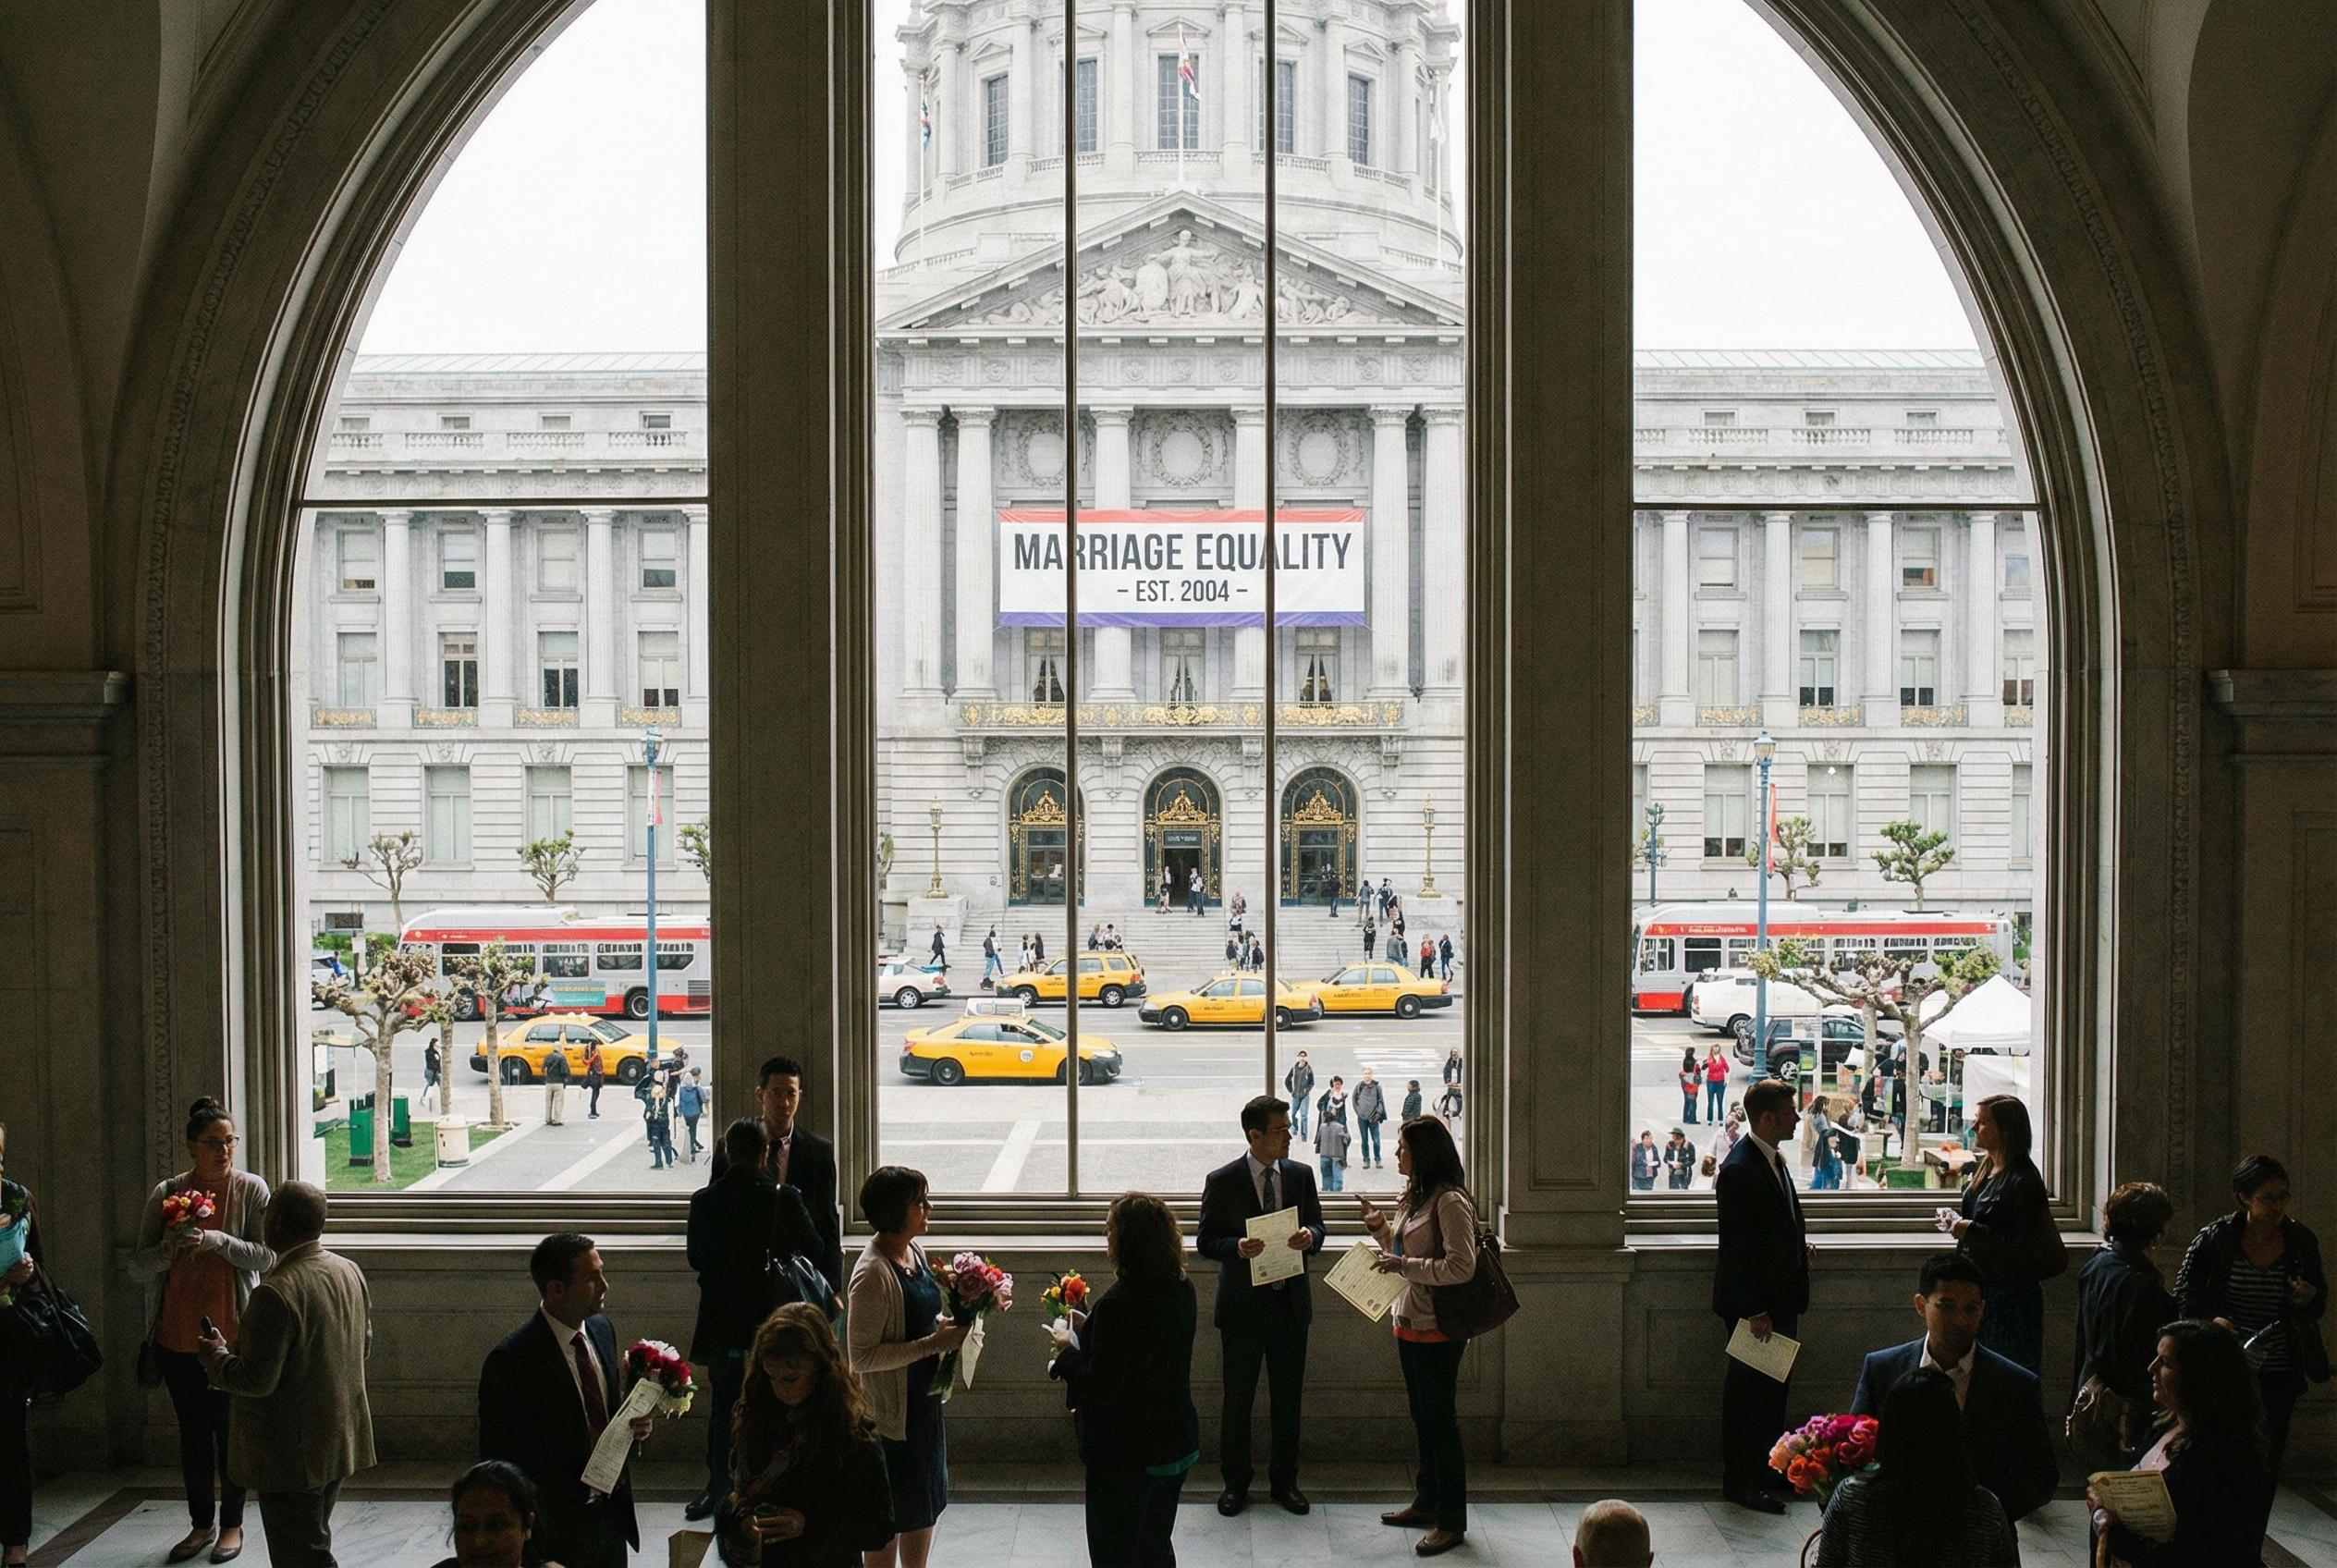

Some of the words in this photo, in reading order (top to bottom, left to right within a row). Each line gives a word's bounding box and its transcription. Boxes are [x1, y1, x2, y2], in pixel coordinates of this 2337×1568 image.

[1014, 533, 1183, 570] MARRIAGE
[1196, 533, 1352, 571] EQUALITY
[1136, 580, 1174, 602] EST.
[1181, 579, 1230, 602] 2004
